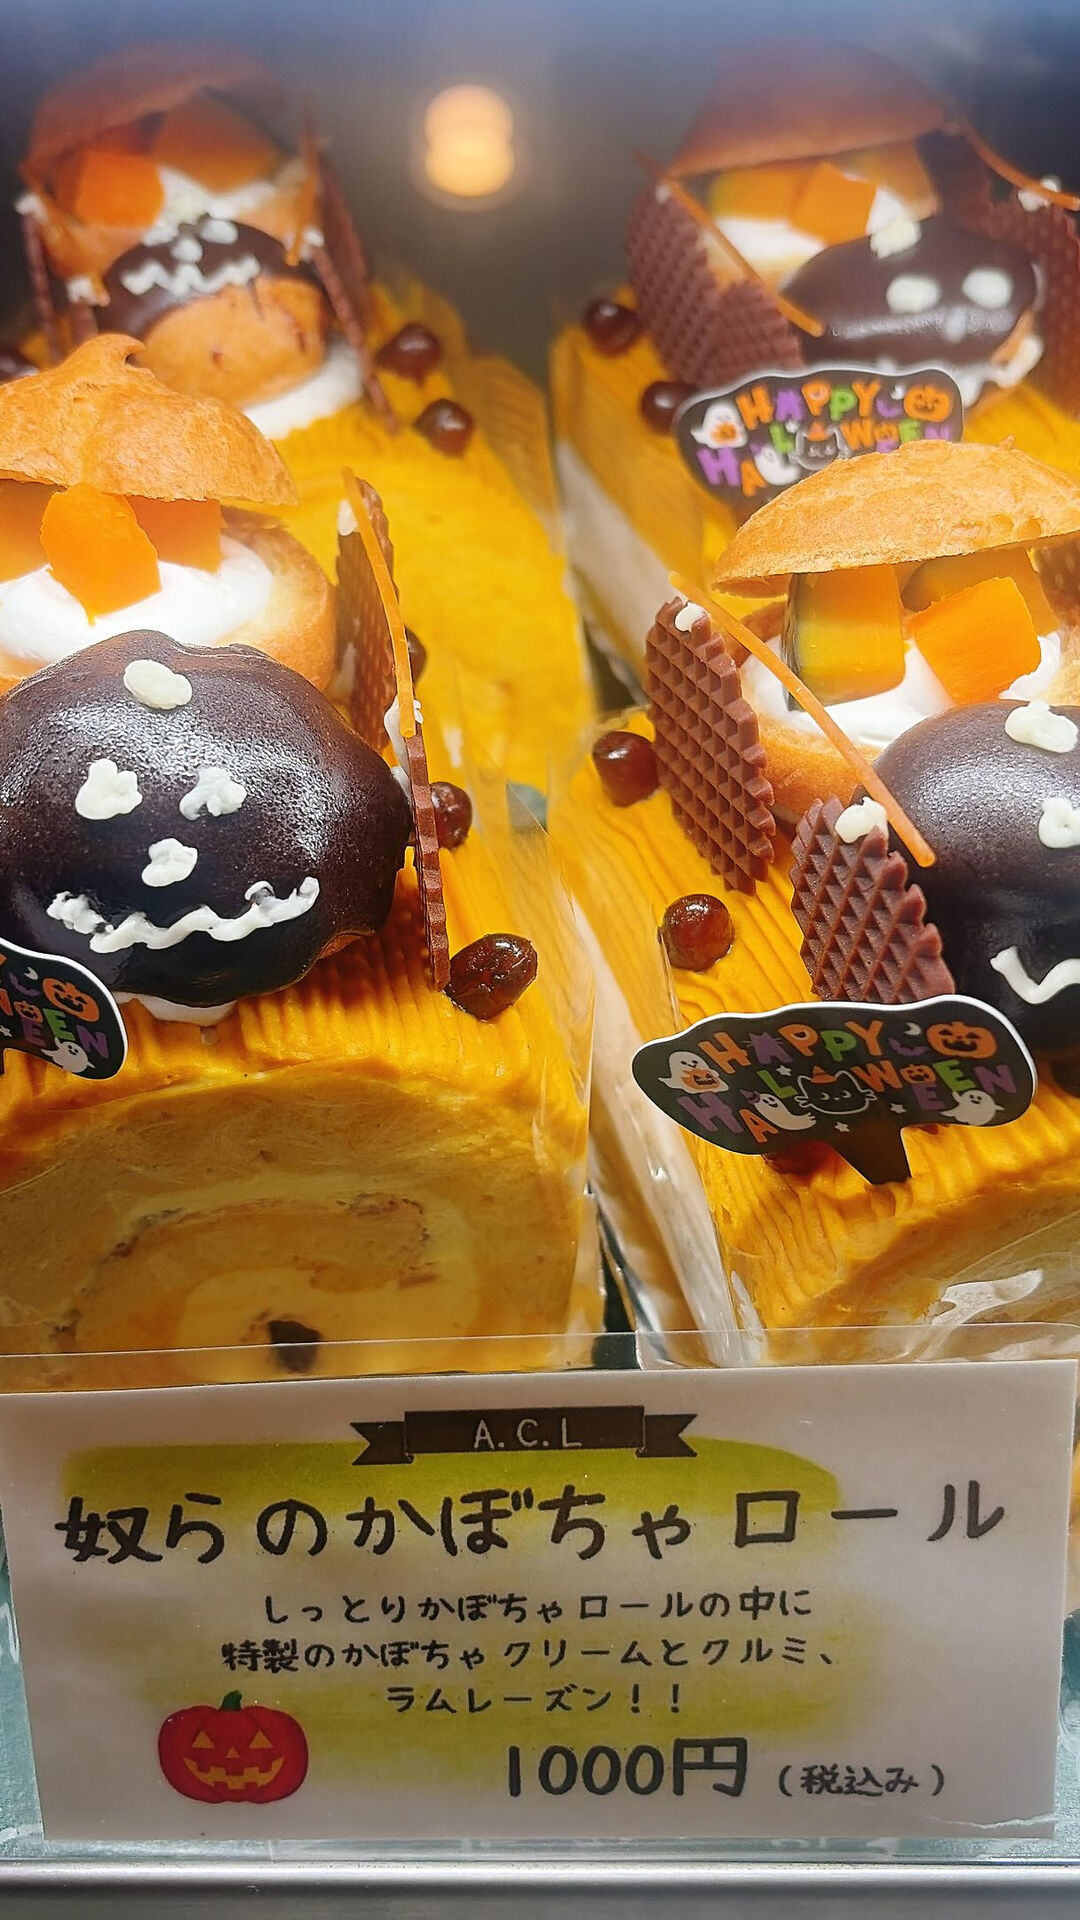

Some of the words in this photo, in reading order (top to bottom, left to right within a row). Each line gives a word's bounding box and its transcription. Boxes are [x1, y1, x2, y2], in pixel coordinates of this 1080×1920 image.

[735, 379, 882, 430] HAPPY
[697, 1020, 883, 1075] HAPPY
[474, 1417, 582, 1450] A.C.L
[55, 1480, 1006, 1566] 奴らのかぼちゃロール
[264, 1585, 812, 1624] しっとりかぼちゃロールの中に
[220, 1637, 833, 1674] 特製のかぼちゃクリームとクルミ、
[386, 1683, 680, 1714] ラムレーズン！！
[508, 1737, 748, 1797] 1000円
[778, 1763, 945, 1797] （税込み）
